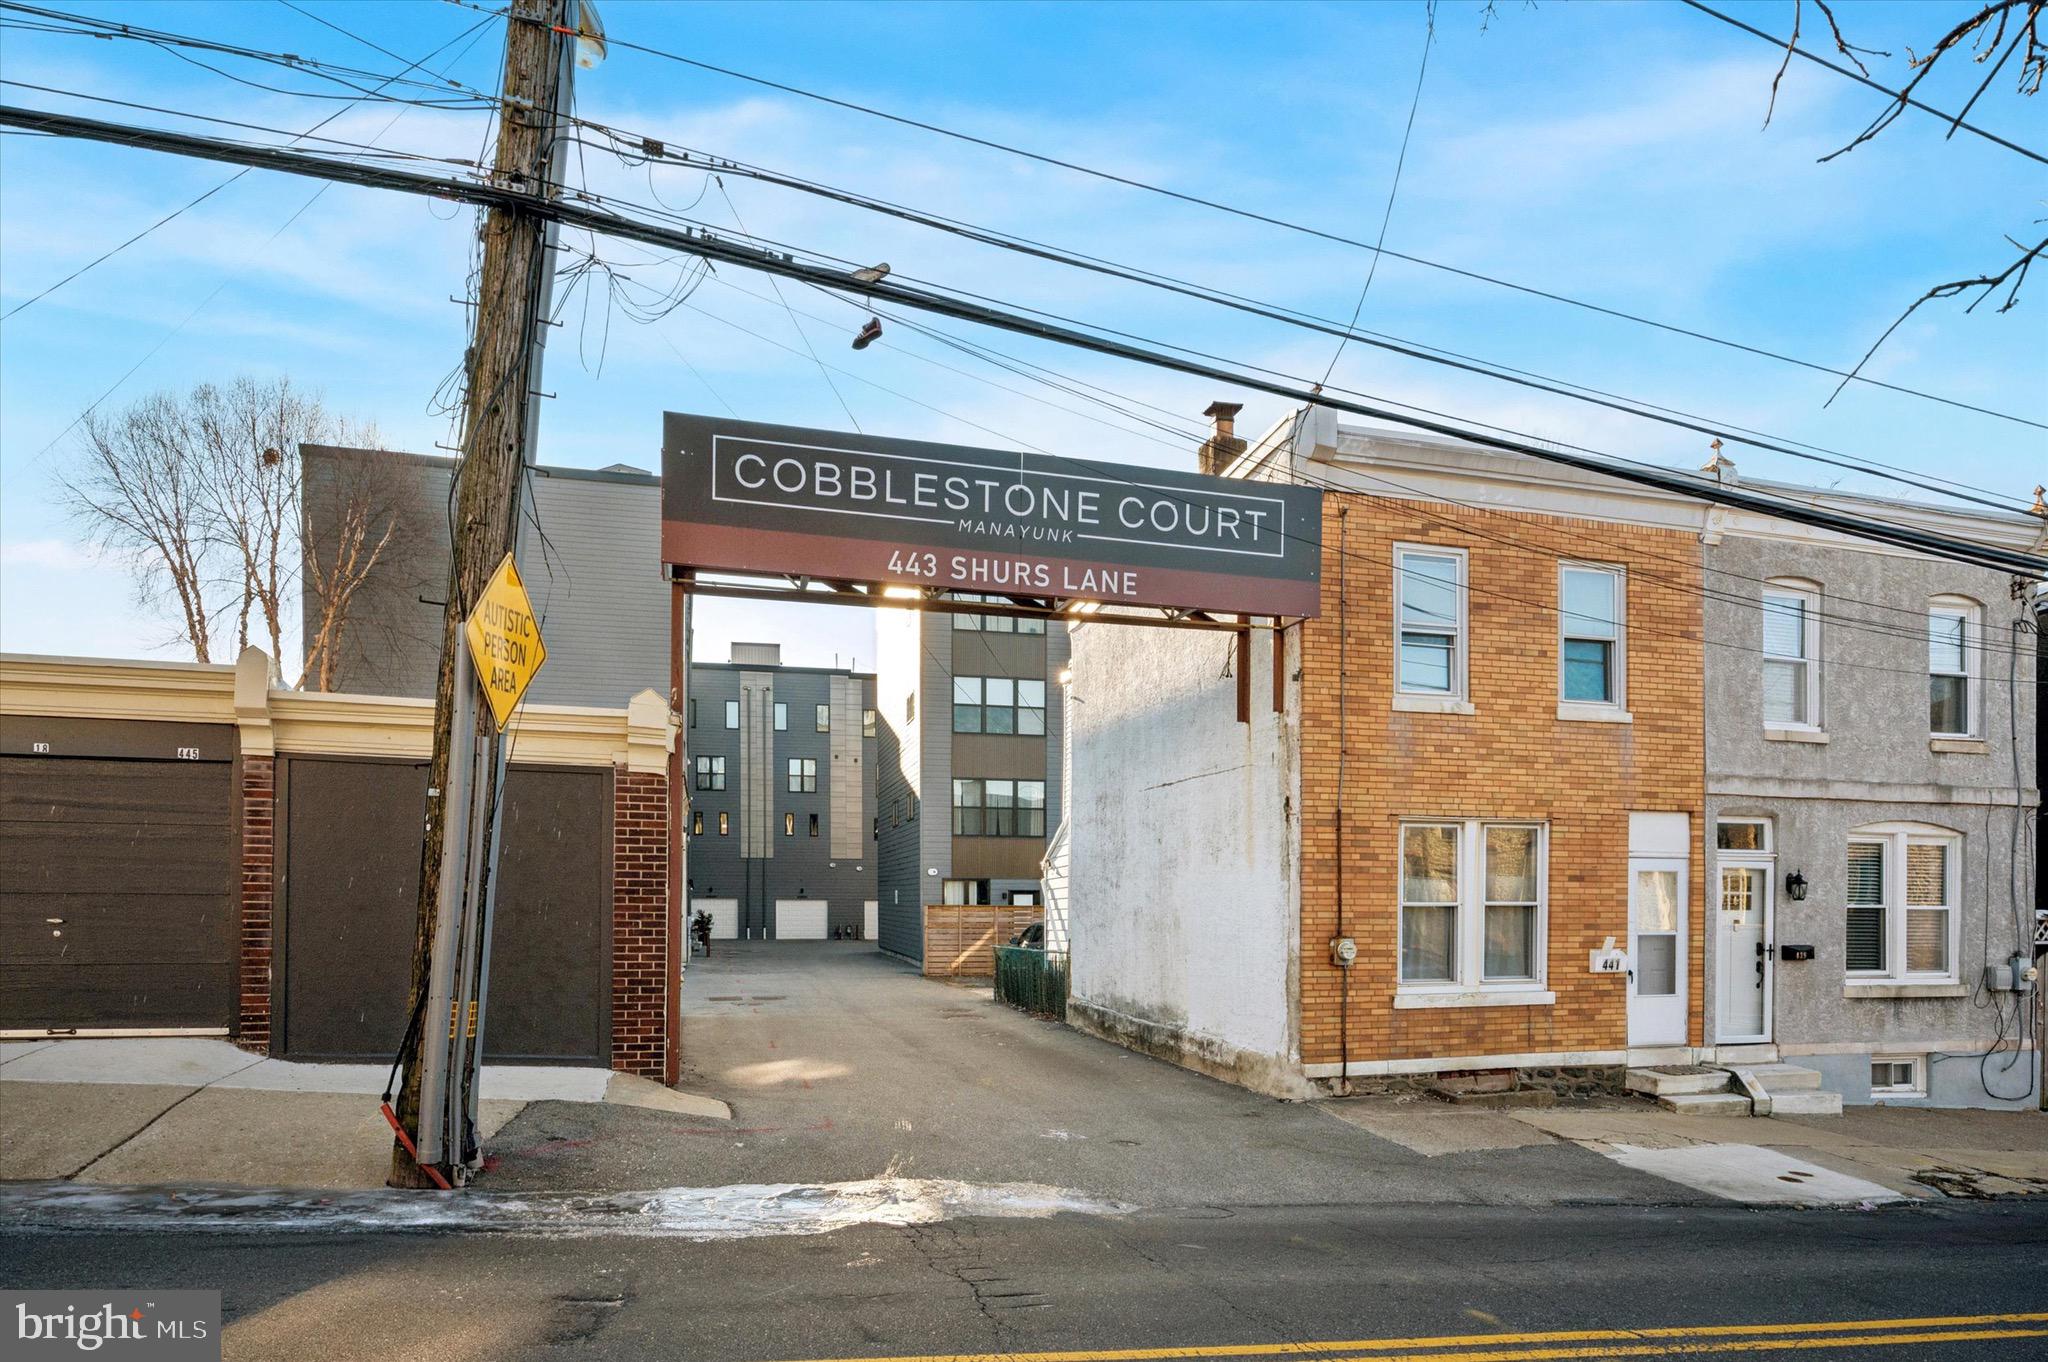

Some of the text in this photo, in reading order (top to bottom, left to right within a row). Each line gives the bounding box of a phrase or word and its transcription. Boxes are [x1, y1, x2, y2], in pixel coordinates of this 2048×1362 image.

[734, 454, 1267, 541] COBBLESTONE COURT
[958, 519, 1073, 543] MANAYUNK
[887, 550, 1138, 595] 443 SHURS LANE
[483, 599, 531, 638] AUTISTIC
[484, 631, 527, 667] PERSON
[490, 667, 517, 695] AREA
[178, 748, 199, 760] 445
